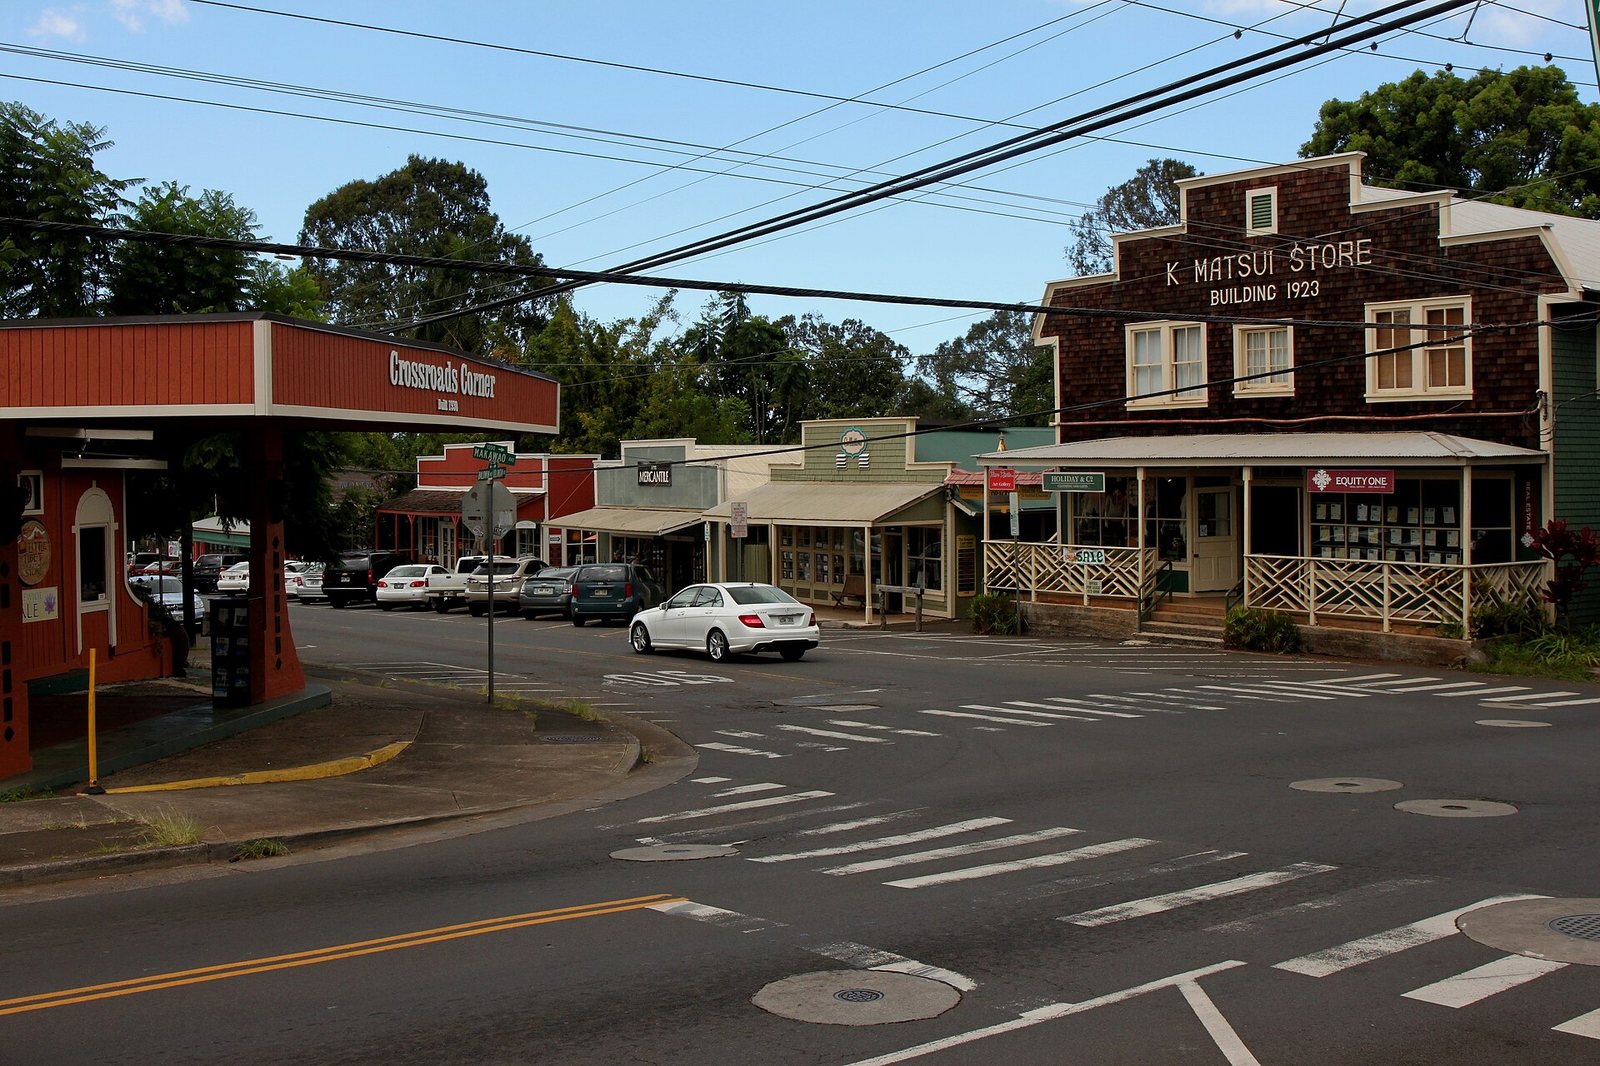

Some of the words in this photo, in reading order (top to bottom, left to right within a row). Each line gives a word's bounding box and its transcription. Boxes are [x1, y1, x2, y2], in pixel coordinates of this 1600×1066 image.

[1166, 261, 1179, 286] K
[1194, 250, 1274, 283] MATSUI
[1290, 238, 1372, 272] STORE
[1210, 284, 1276, 306] BUILDING
[1287, 280, 1320, 299] 1923
[389, 350, 458, 394] Crossroads
[460, 363, 496, 398] Corner
[473, 447, 507, 463] MAKAWAO
[639, 470, 669, 483] MERCANTILE
[1051, 475, 1078, 483] HOLIDAY
[1335, 476, 1367, 487] EQUITY
[1368, 476, 1388, 486] ONE
